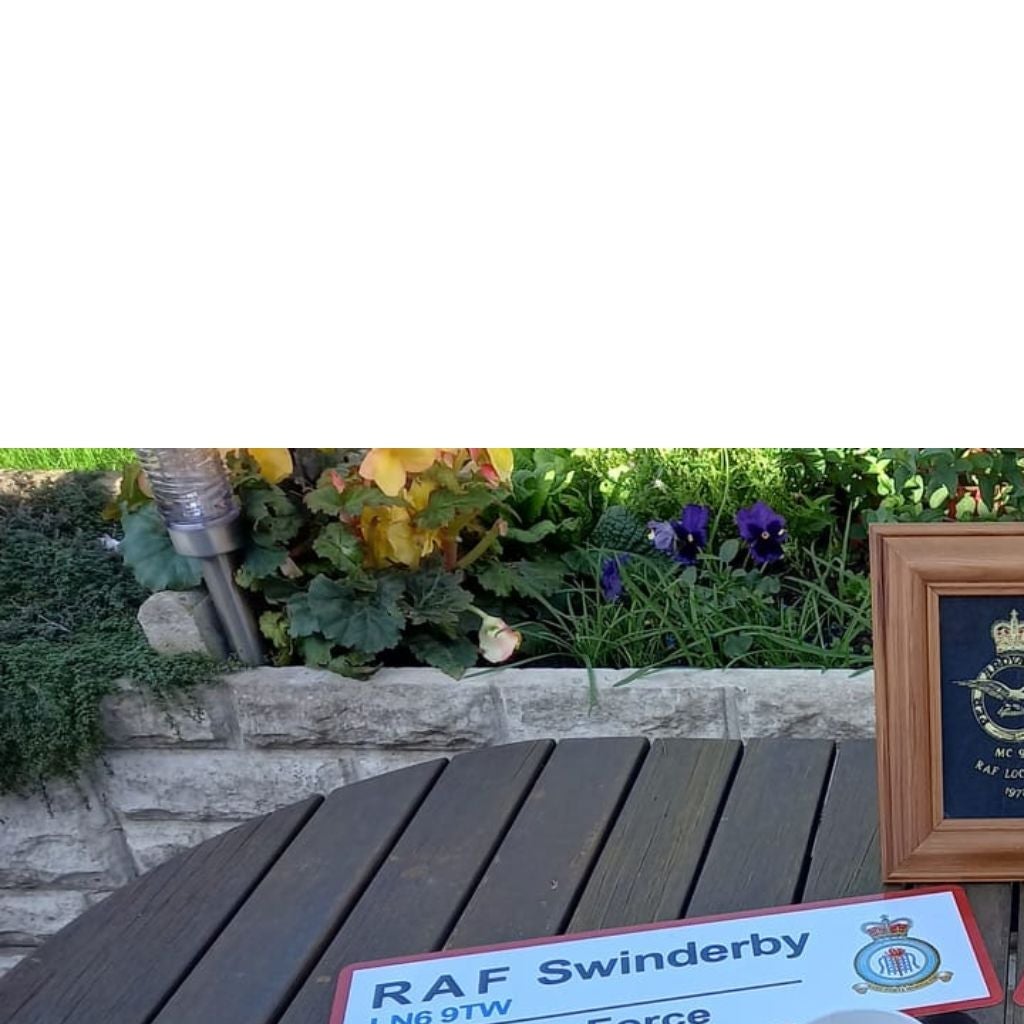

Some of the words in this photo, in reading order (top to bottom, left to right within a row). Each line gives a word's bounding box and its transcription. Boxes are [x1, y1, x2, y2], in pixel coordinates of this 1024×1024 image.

[994, 747, 1014, 758] MC
[974, 759, 1000, 775] RAF
[372, 967, 511, 1010] RAF
[538, 931, 811, 985] Swinderby
[441, 998, 513, 1024] 9TW
